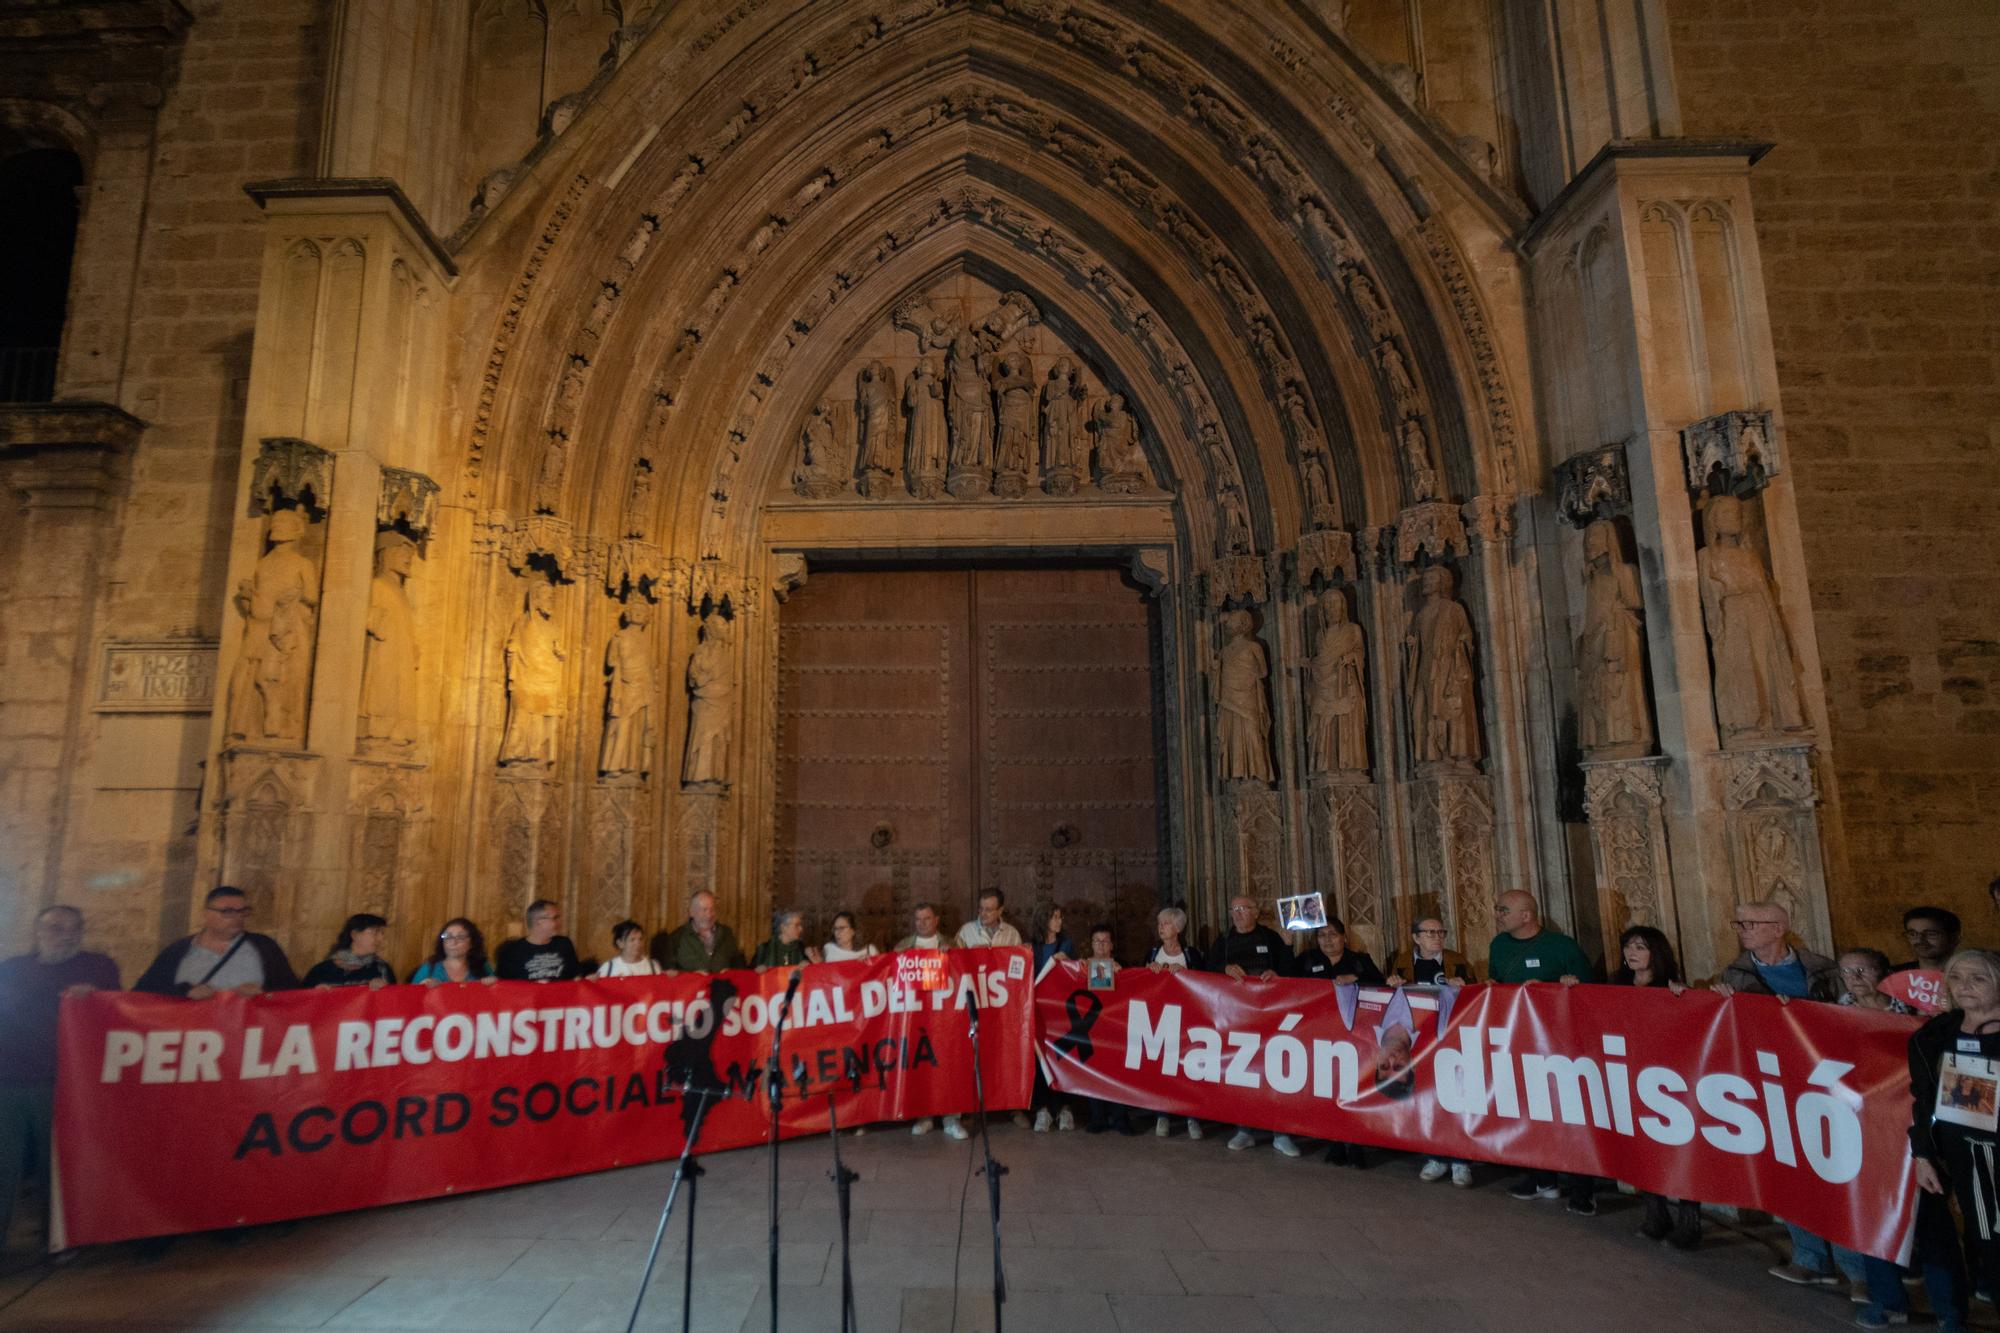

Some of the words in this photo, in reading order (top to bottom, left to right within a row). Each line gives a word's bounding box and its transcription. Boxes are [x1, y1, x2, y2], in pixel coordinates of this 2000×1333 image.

[896, 955, 942, 969] Volem
[1909, 973, 1940, 993] Vol
[100, 1030, 225, 1084] PER
[240, 1024, 317, 1080] LA
[334, 991, 714, 1071] RECONSTRUCCIÓ
[722, 986, 854, 1036] SOCIAL
[860, 976, 922, 1018] DEL
[932, 965, 1009, 1011] PAÍS
[232, 1092, 471, 1160] ACORD
[489, 1070, 676, 1127] SOCIAL
[1125, 999, 1359, 1102] Mazón
[1433, 1026, 1863, 1184] dimissió
